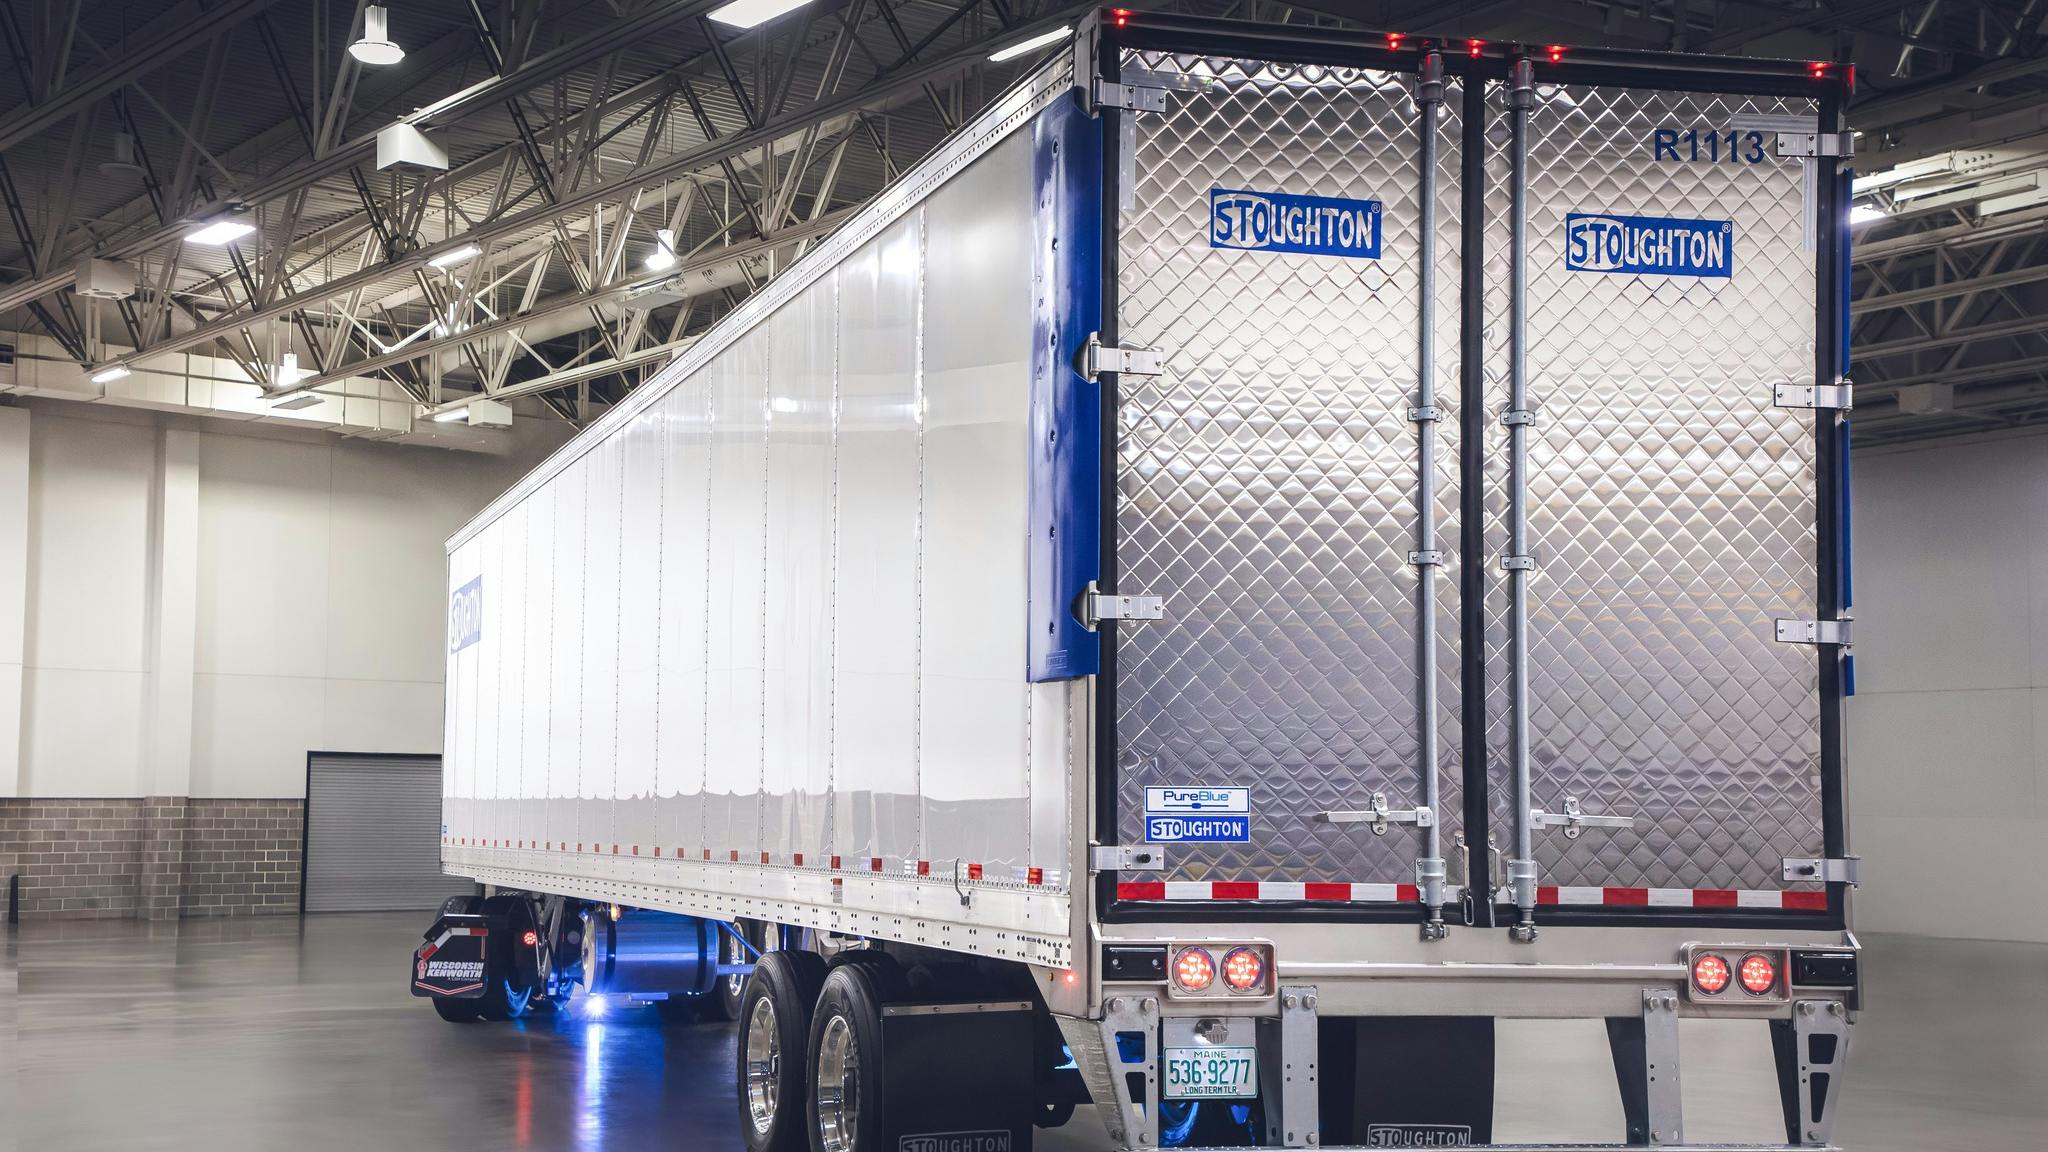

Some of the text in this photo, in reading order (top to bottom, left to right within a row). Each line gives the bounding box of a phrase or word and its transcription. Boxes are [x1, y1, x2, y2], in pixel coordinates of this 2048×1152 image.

[1654, 129, 1764, 164] R1113
[1215, 199, 1373, 250] STOUGHTON
[1570, 222, 1724, 269] STOUGHTON
[1163, 790, 1230, 802] PureBlue
[1151, 820, 1242, 838] STOUGHTON
[429, 961, 484, 970] WISCONSIN
[426, 969, 483, 978] KENWORTH
[1194, 1050, 1227, 1059] MAINE
[1184, 1086, 1237, 1095] LONG TERM TLR
[1370, 1128, 1468, 1146] STOUGHTON
